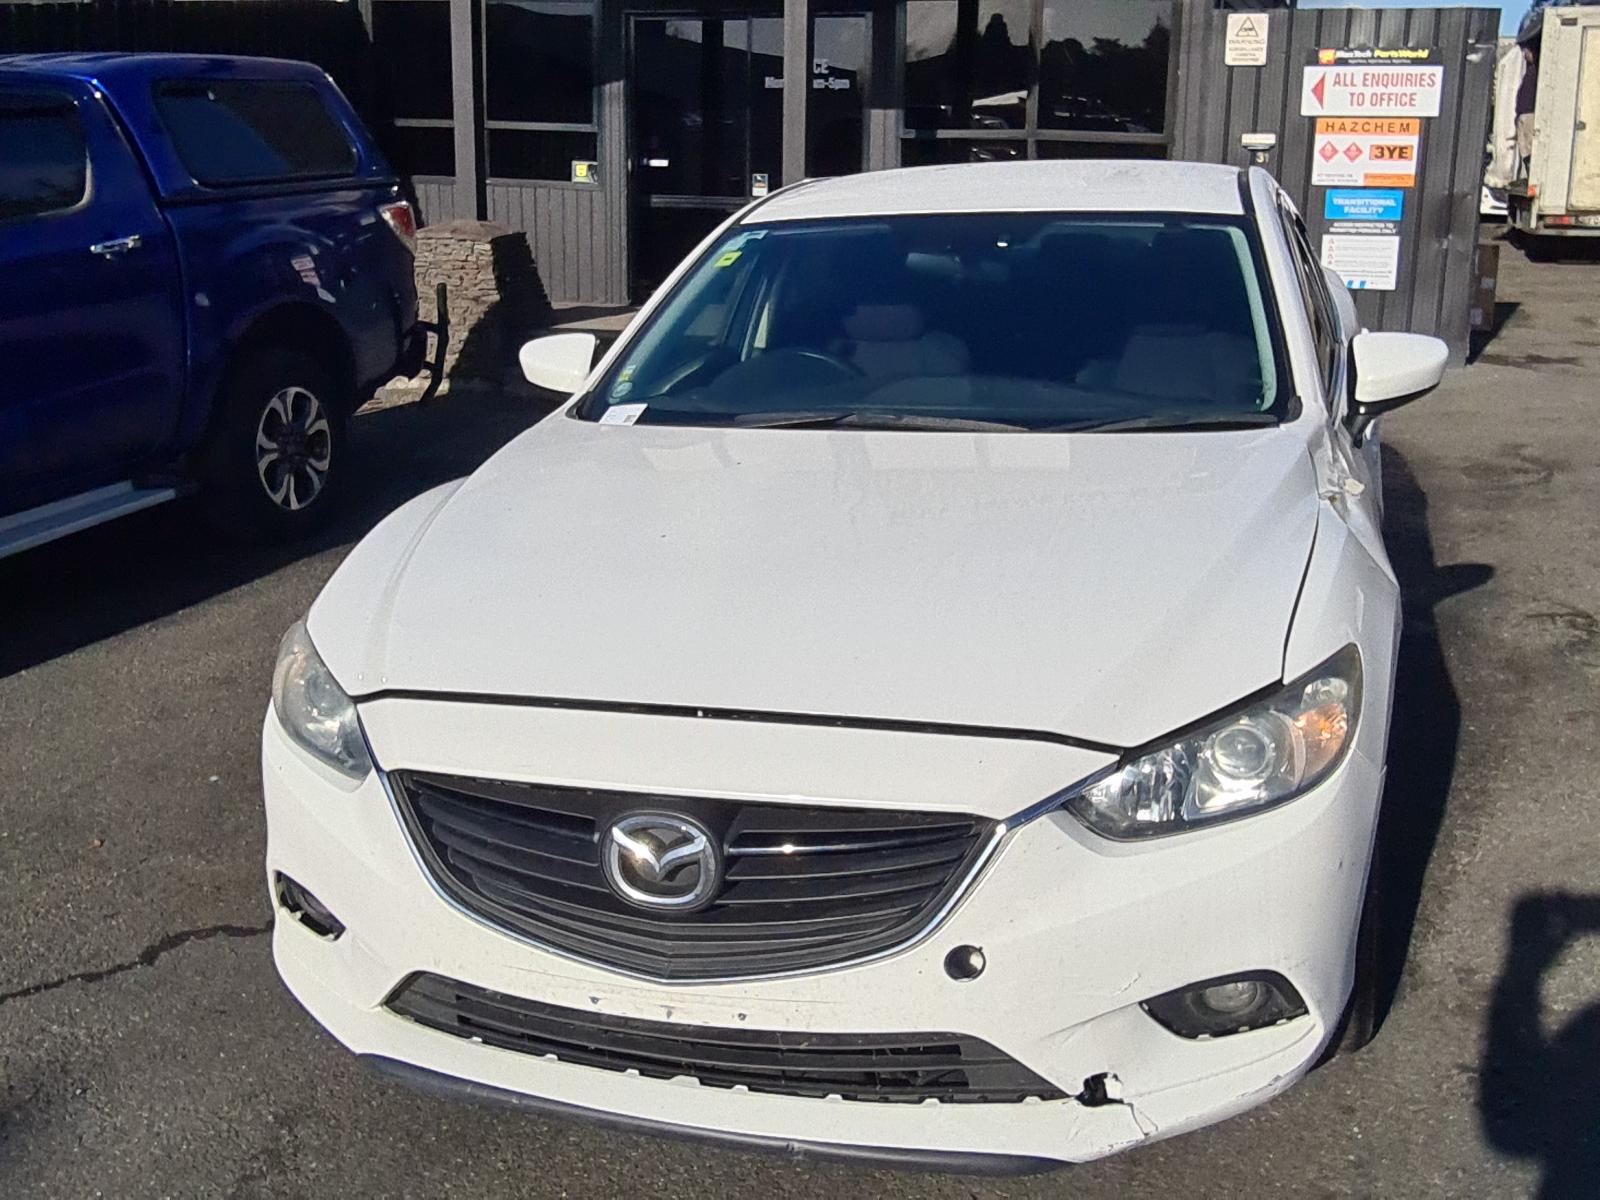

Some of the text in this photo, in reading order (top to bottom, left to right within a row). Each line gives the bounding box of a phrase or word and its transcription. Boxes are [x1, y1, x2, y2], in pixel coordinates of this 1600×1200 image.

[1333, 72, 1436, 88] ALL ENQUIRIES
[1349, 92, 1417, 107] TO OFFICE
[1325, 121, 1410, 133] HAZCHEM
[1374, 146, 1409, 159] 3YE
[1333, 198, 1397, 206] TRANSITIONAL
[1343, 206, 1384, 214] FACILITY
